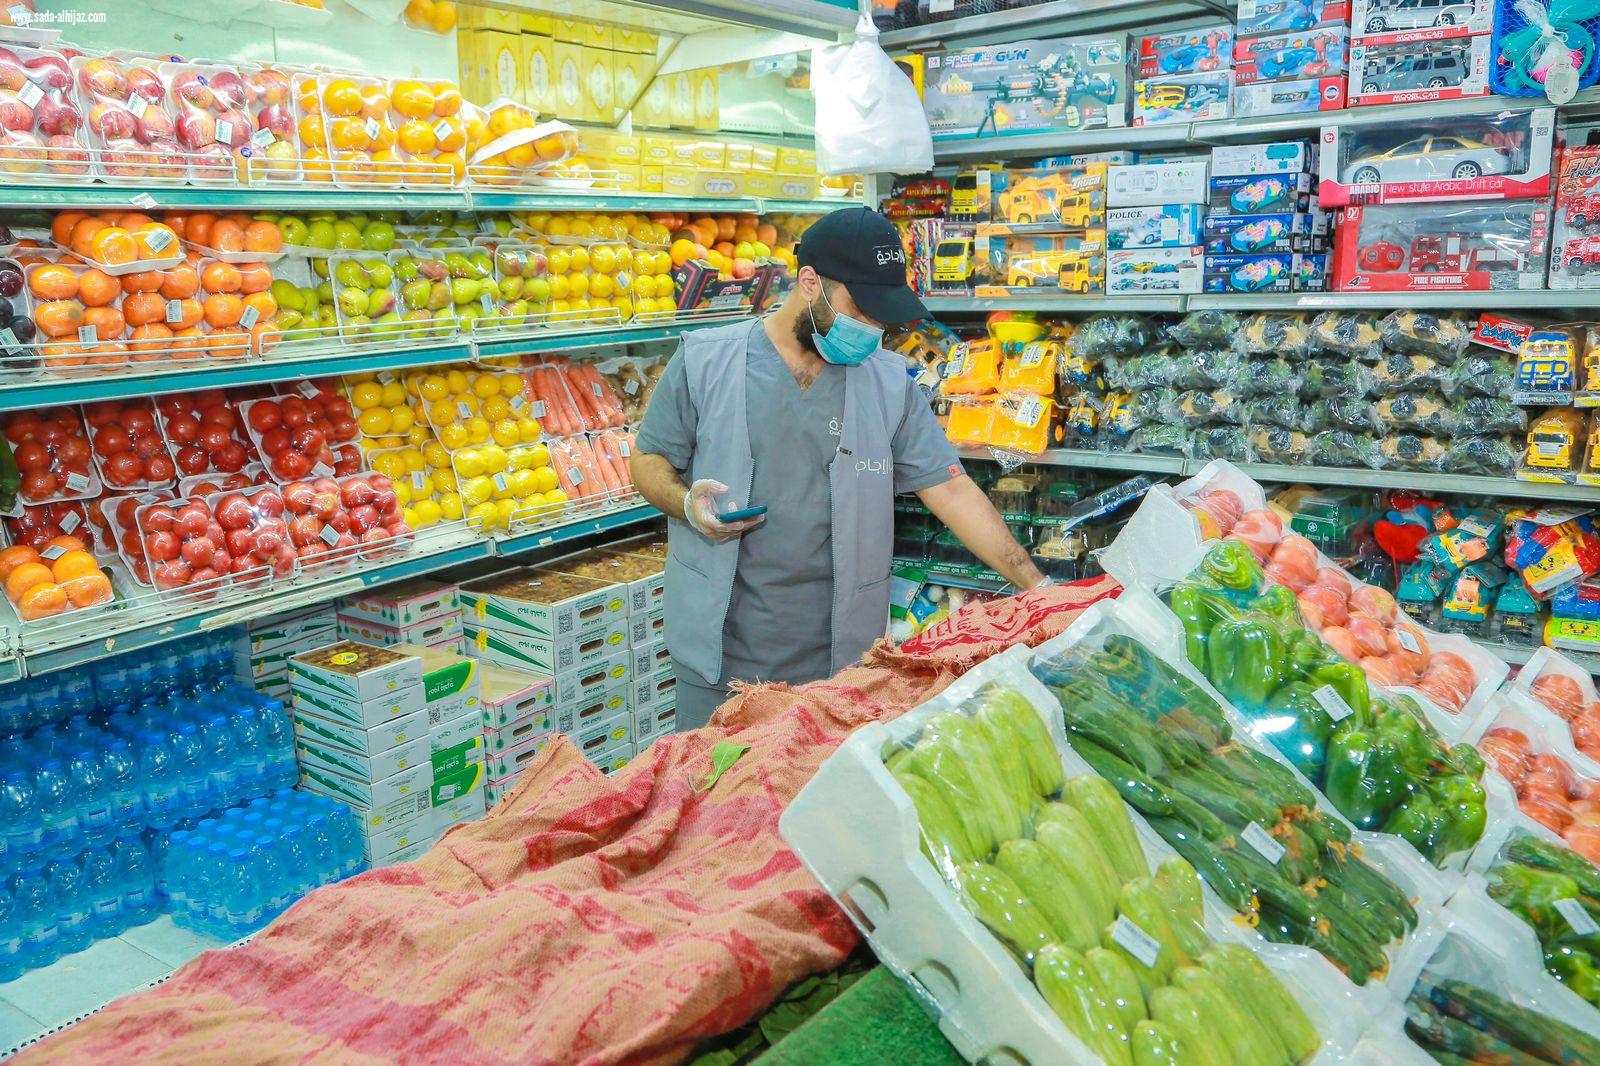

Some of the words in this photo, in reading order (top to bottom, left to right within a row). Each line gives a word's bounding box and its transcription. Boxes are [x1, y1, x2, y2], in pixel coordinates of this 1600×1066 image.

[1424, 30, 1443, 39] CAR
[996, 48, 1031, 62] GUN
[1420, 91, 1440, 100] CAR
[1564, 157, 1600, 177] FIR
[1384, 183, 1405, 194] New
[1409, 181, 1431, 194] style
[1434, 180, 1461, 191] Arabic
[1465, 179, 1487, 190] Drift
[1489, 179, 1505, 188] car
[1109, 210, 1143, 219] POLICE
[1413, 275, 1428, 284] FIRE
